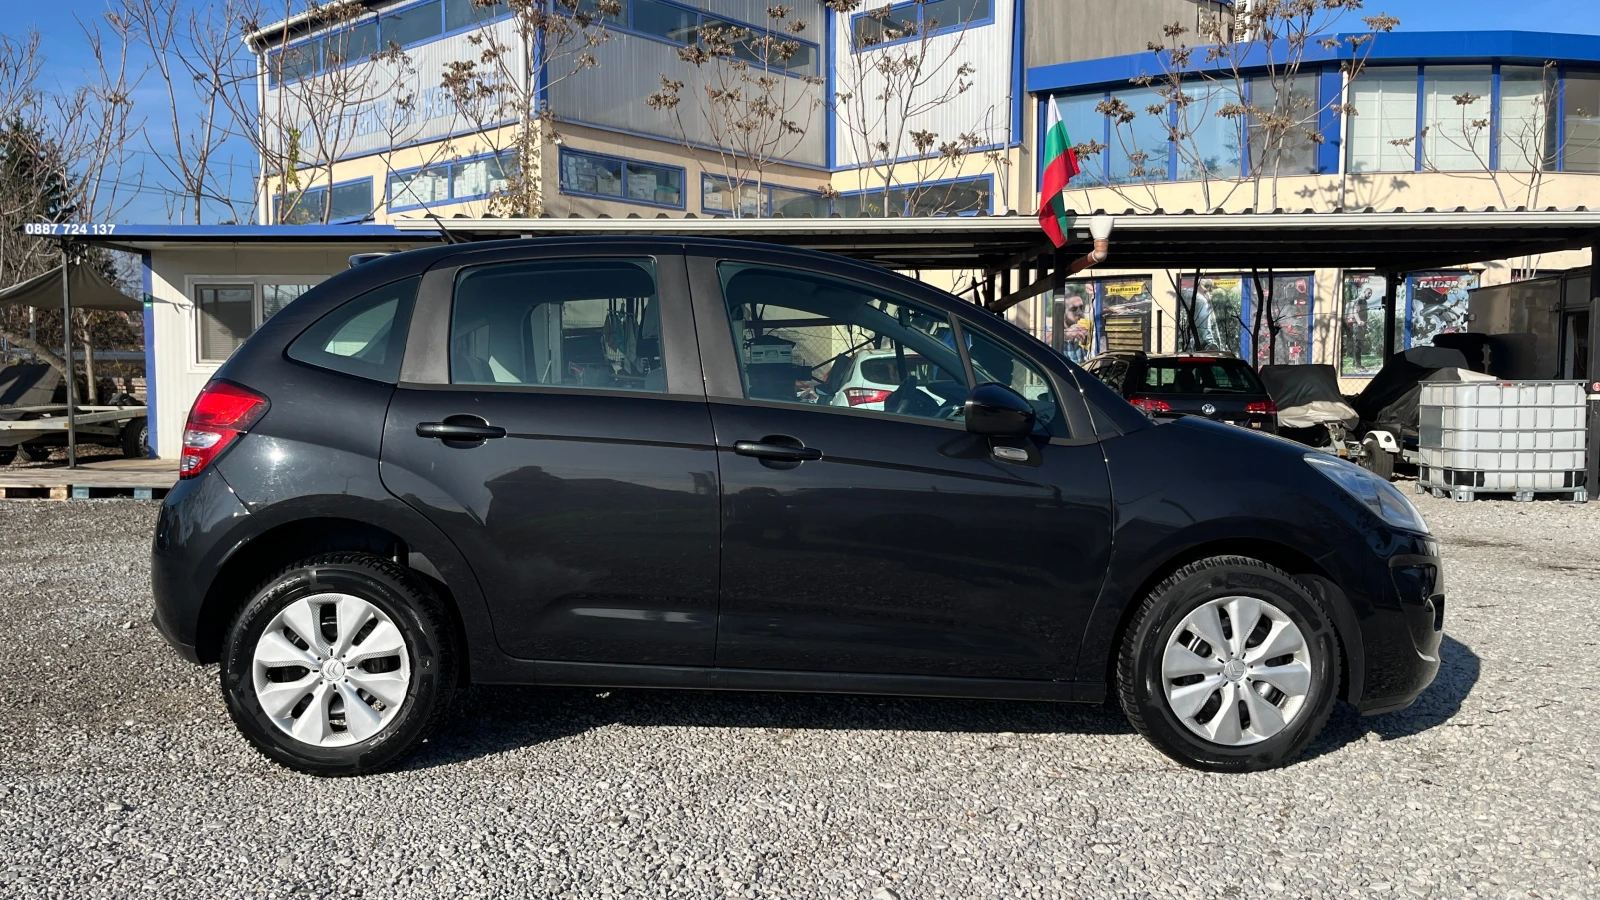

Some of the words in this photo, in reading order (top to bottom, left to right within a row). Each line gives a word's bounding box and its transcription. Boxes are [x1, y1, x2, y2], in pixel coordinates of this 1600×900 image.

[26, 223, 58, 234] 0887
[62, 223, 87, 234] 724
[92, 223, 115, 234] 137
